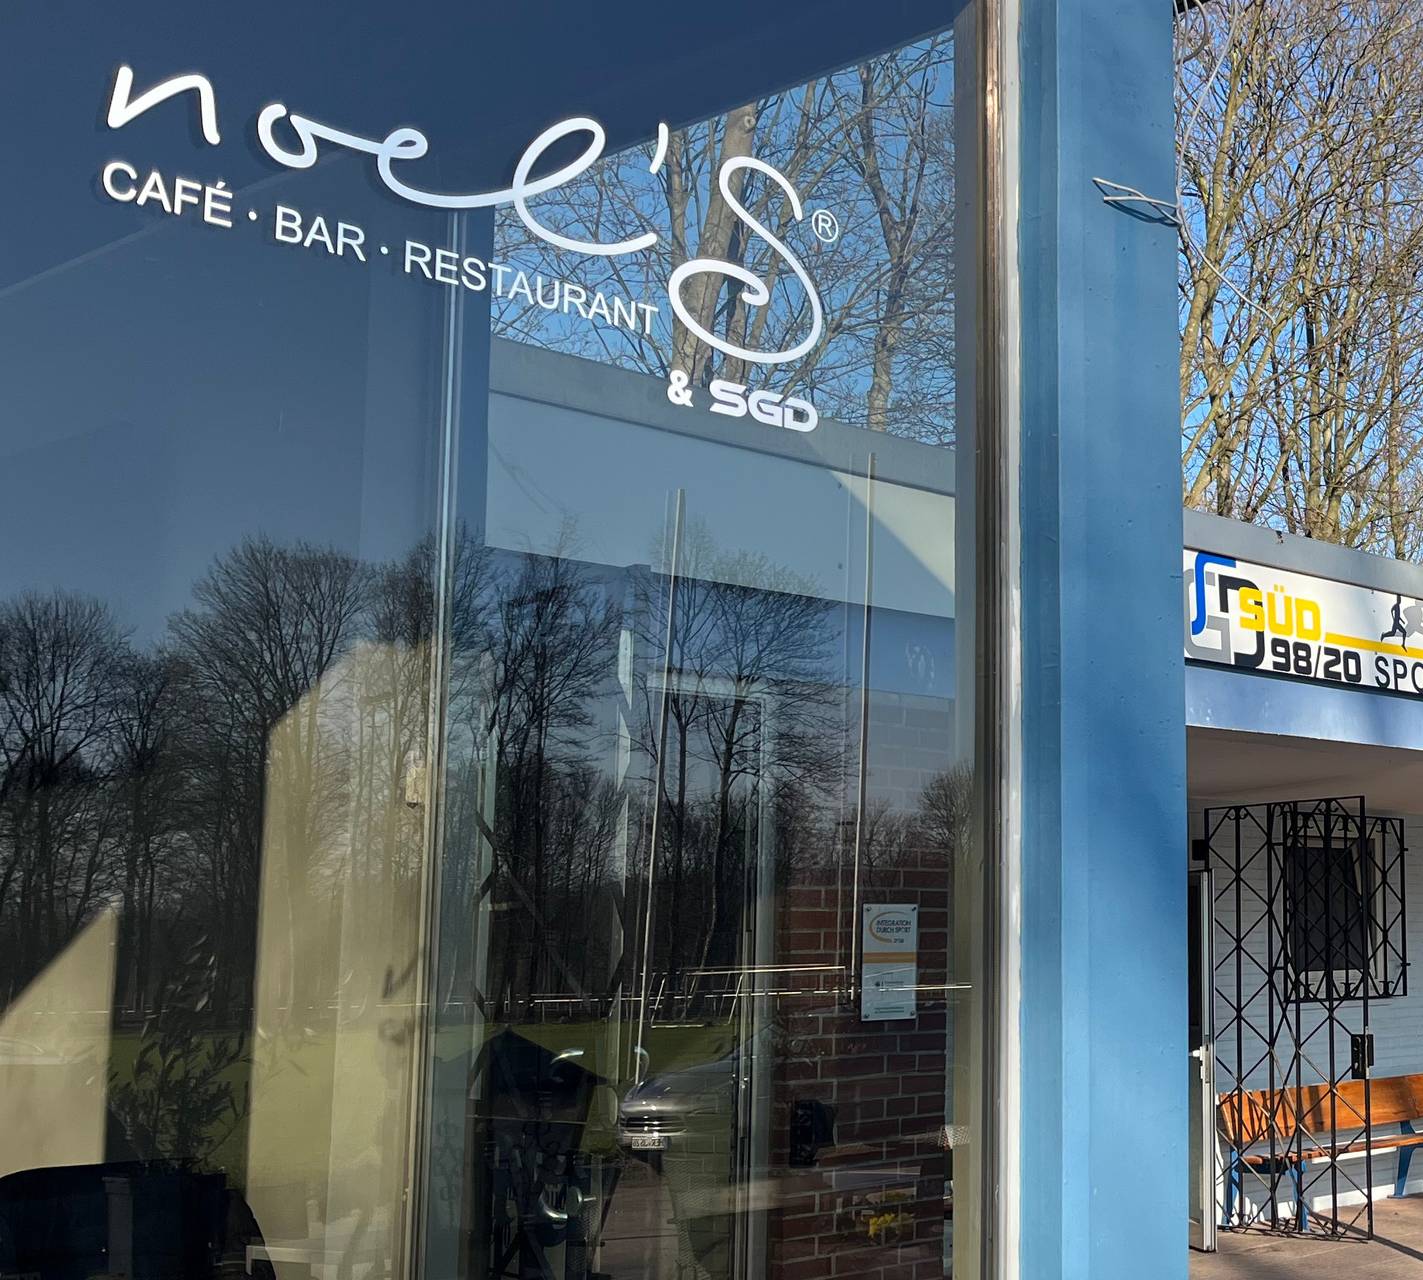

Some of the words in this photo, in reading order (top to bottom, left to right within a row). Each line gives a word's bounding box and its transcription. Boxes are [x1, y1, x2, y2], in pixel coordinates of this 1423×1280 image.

[101, 160, 234, 229] CAFÉ
[275, 205, 367, 264] BAR
[403, 240, 660, 337] RESTAURANT
[666, 370, 694, 409] &
[708, 383, 819, 434] SGD
[1238, 583, 1322, 642] SÜD
[1270, 637, 1362, 683] 98/20
